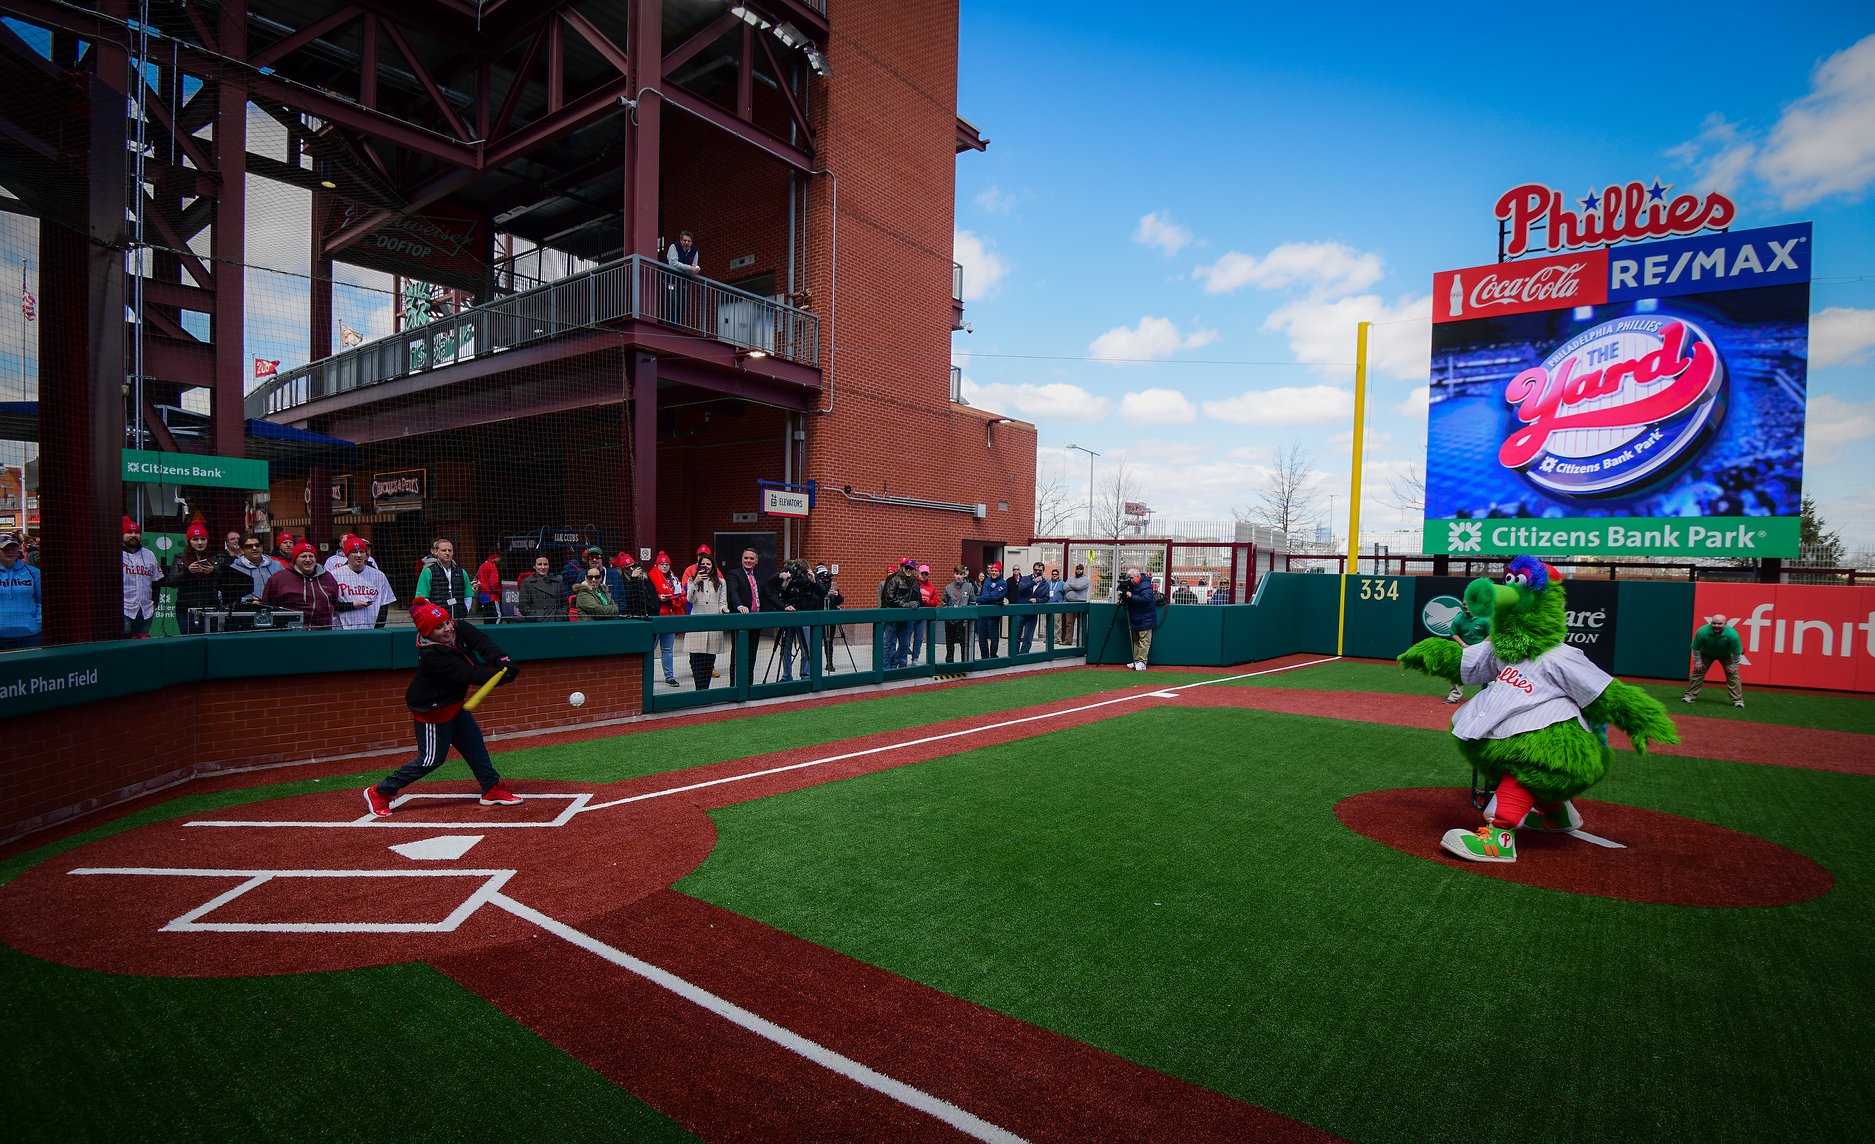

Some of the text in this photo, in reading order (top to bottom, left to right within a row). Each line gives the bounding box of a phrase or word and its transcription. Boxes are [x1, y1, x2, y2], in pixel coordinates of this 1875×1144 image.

[1494, 179, 1736, 258] Phillies
[371, 232, 433, 257] OOFTOP
[1611, 237, 1800, 291] RE/MAX
[1470, 262, 1588, 309] Coca-Cola
[1548, 319, 1663, 368] PHILADELPHIA PHILLIES
[1586, 341, 1620, 367] THE
[1498, 321, 1714, 468] Yard
[1555, 429, 1663, 474] Citizens Bank Park
[141, 463, 222, 478] Citizens Bank
[779, 497, 803, 508] ELEVATORS
[1491, 524, 1756, 548] Citizens Bank Park
[338, 583, 379, 597] Phillies
[1360, 579, 1400, 601] 334
[1565, 610, 1607, 628] are
[0, 668, 98, 699] ank Phan Field
[1500, 832, 1511, 848] P
